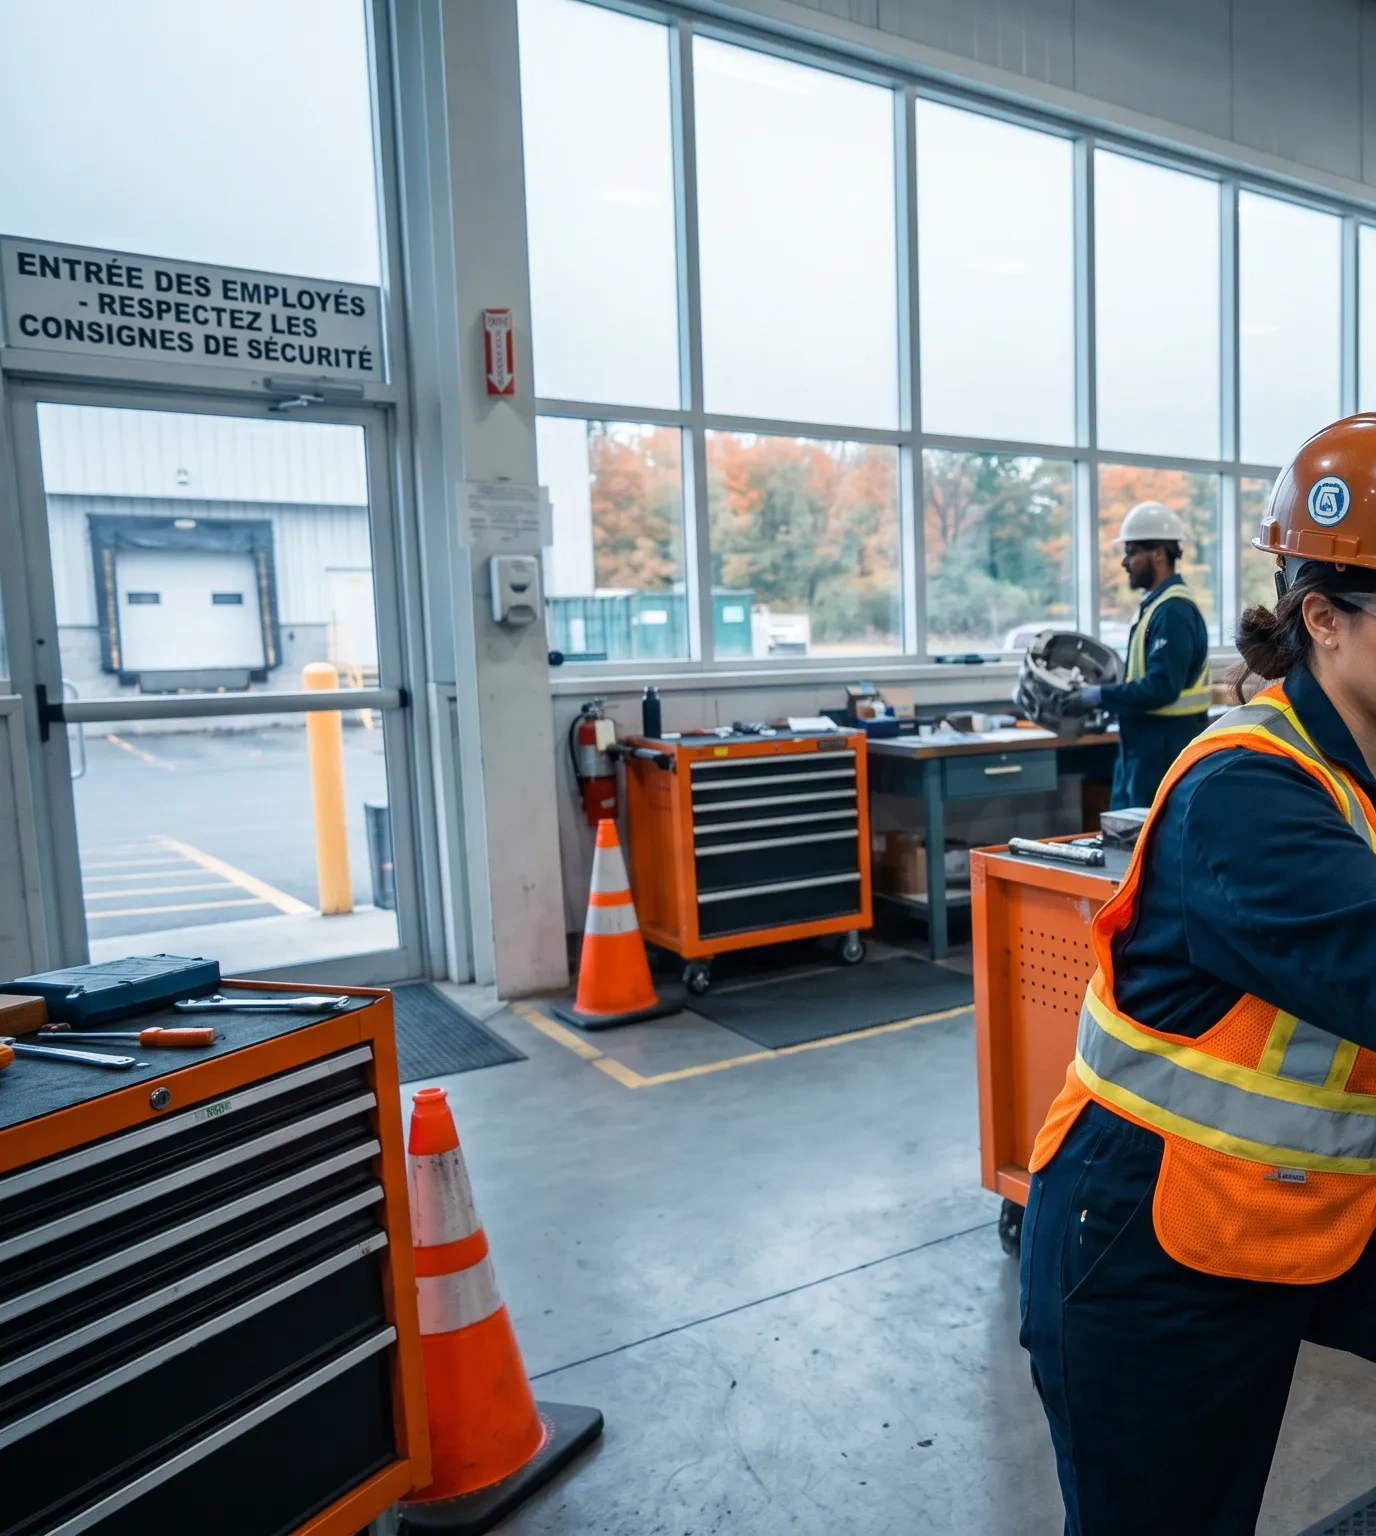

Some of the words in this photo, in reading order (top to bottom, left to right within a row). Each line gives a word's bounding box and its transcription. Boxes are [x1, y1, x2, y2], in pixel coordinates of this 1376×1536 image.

[16, 251, 144, 290] ENTRÉE
[154, 270, 212, 298] DES
[221, 279, 366, 317] EMPLOYÉS
[18, 313, 194, 353] CONSIGNES
[203, 334, 239, 358] DE
[247, 336, 373, 371] SÉCURITÉ
[97, 292, 263, 332] RESPECTEZ
[270, 313, 318, 338] LES
